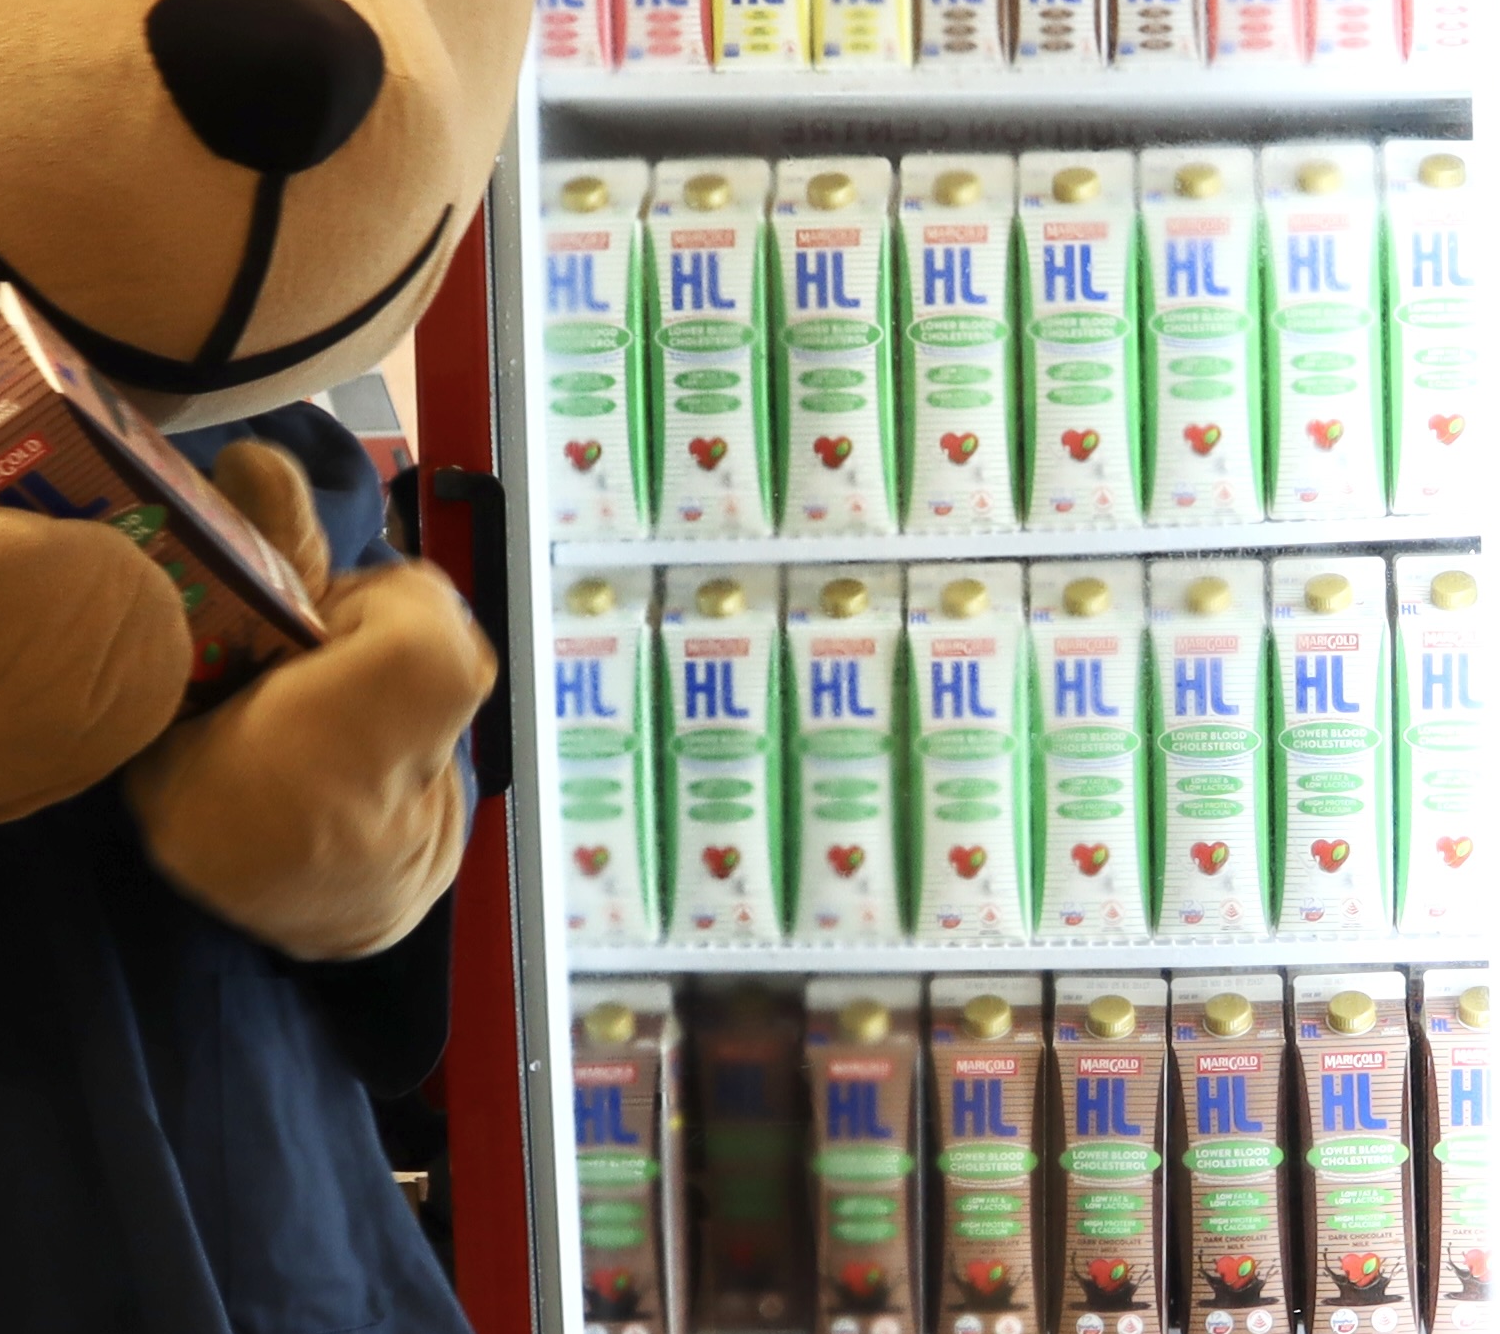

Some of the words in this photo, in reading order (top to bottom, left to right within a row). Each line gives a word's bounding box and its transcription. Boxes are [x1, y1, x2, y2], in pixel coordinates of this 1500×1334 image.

[796, 251, 862, 309] HL
[923, 246, 989, 306] HL
[1043, 243, 1110, 304] HL
[1298, 635, 1358, 650] MARIGOLD
[683, 660, 751, 721] HL
[931, 660, 997, 720] HL
[1053, 658, 1121, 718] HL
[1173, 657, 1240, 717] HL
[1293, 654, 1360, 715] HL
[1171, 731, 1207, 741] LOWER
[1210, 731, 1247, 741] BLOOD
[1171, 741, 1247, 752] CHOLESTEROL
[1199, 1055, 1258, 1071] MARIGOLD
[1324, 1053, 1383, 1069] MARIGOLD
[1077, 1078, 1141, 1136] HL
[1197, 1075, 1264, 1134] HL
[1321, 1072, 1389, 1132] HL
[1319, 1145, 1357, 1156] LOWER
[1359, 1144, 1396, 1154] BLOOD
[1320, 1155, 1395, 1166] CHOLESTEROL
